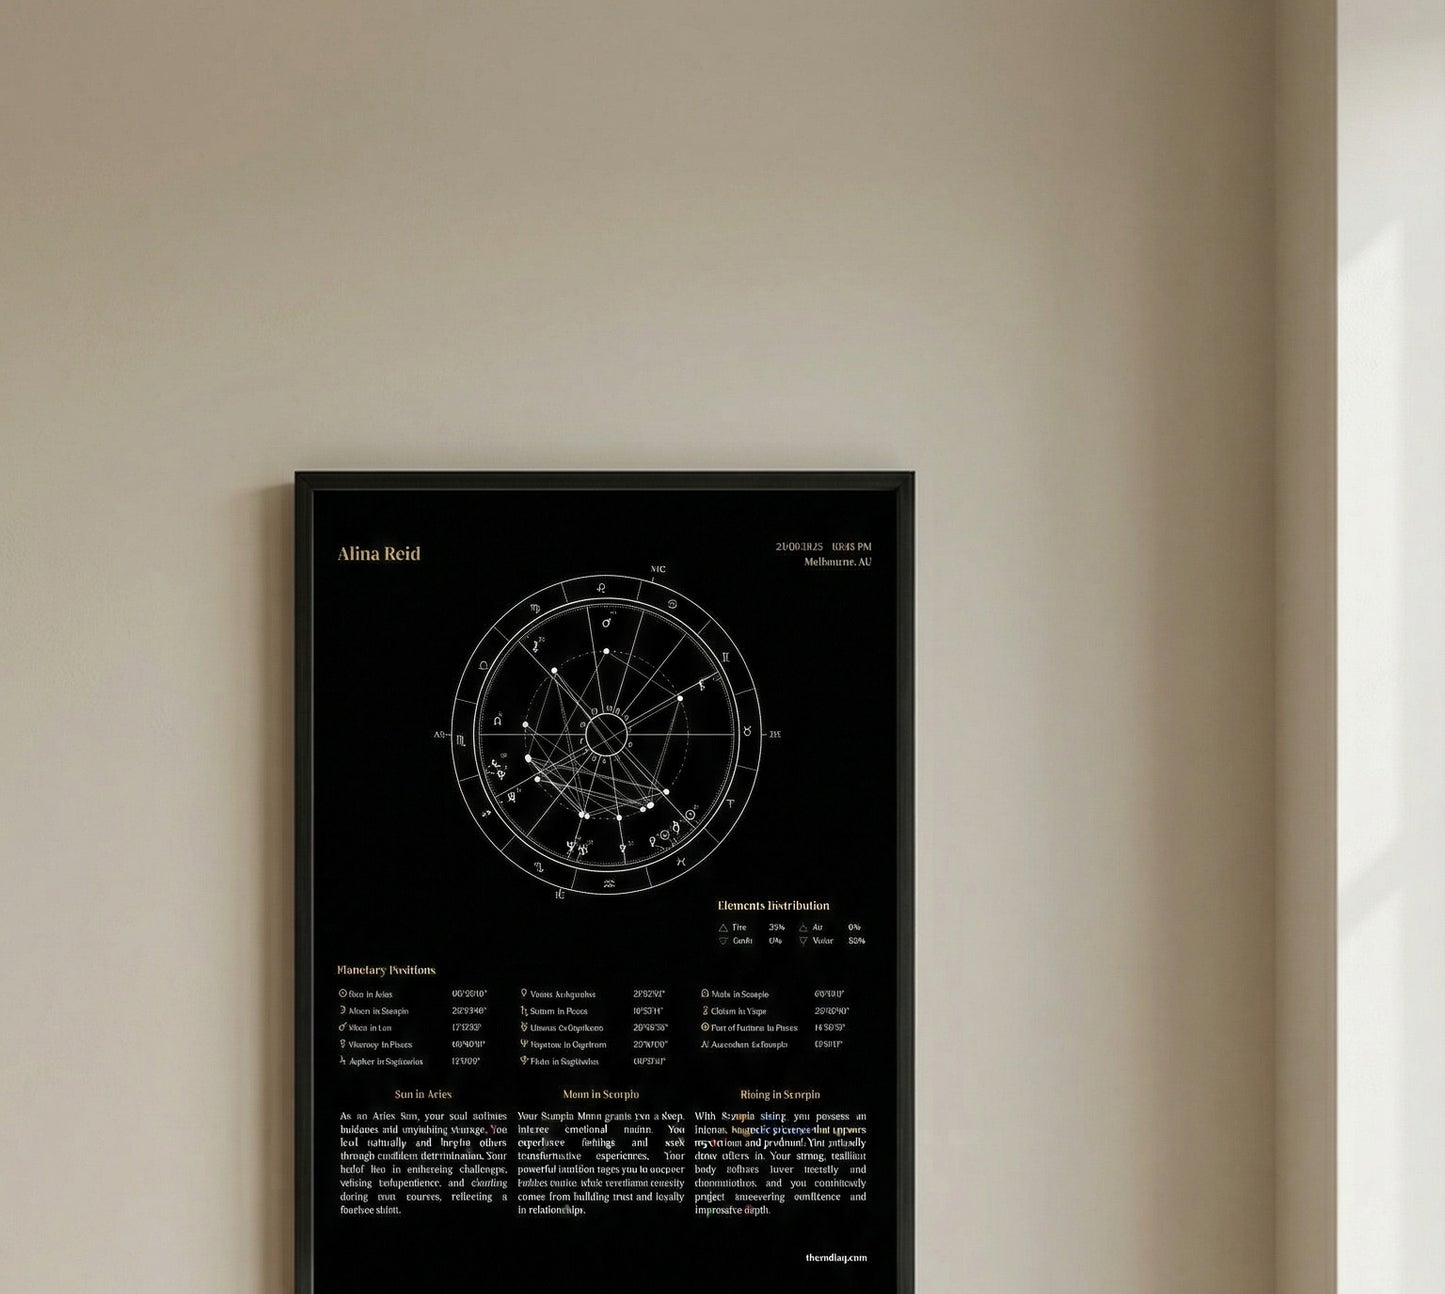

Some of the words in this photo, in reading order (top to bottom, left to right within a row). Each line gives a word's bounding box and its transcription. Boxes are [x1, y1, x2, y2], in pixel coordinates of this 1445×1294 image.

[338, 546, 379, 560] Alina
[385, 546, 420, 560] Reid
[592, 1090, 600, 1098] in
[773, 1090, 781, 1099] in
[340, 1112, 351, 1120] As
[425, 1114, 444, 1122] your
[449, 1112, 467, 1120] soul
[416, 1137, 431, 1147] and
[745, 1138, 761, 1147] and
[770, 1151, 791, 1160] Your
[393, 1165, 401, 1173] in
[518, 1165, 556, 1175] powerful
[695, 1165, 716, 1176] body
[448, 1178, 464, 1187] and
[766, 1178, 782, 1187] and
[791, 1181, 806, 1189] you
[550, 1192, 570, 1201] from
[636, 1192, 652, 1200] and
[519, 1206, 526, 1214] in
